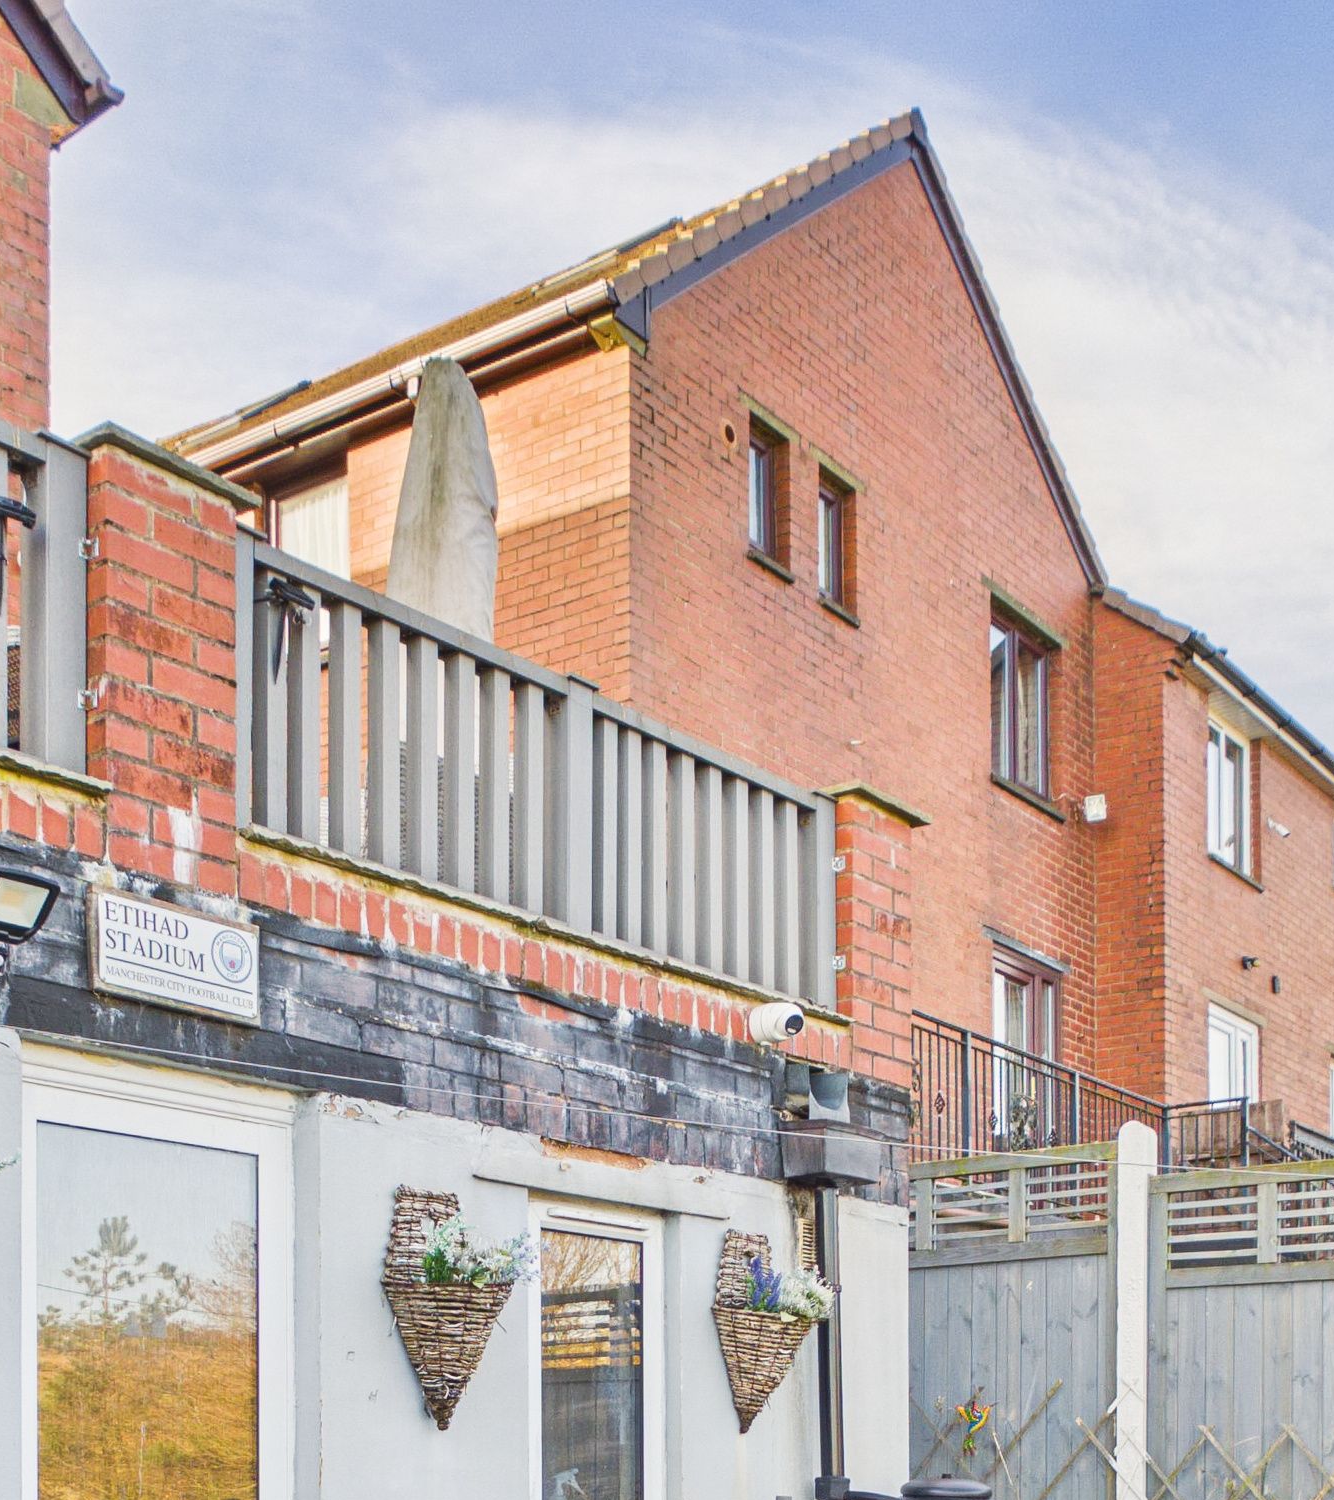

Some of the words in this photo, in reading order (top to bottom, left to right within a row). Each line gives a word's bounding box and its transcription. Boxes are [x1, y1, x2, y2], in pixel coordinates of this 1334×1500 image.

[105, 901, 189, 940] ETIHAD
[105, 928, 205, 972] STADIUM
[106, 965, 166, 988] MANCHESTER
[167, 979, 187, 992] CITY
[188, 985, 229, 1003] FOOTBALL
[232, 997, 253, 1010] CLUB
